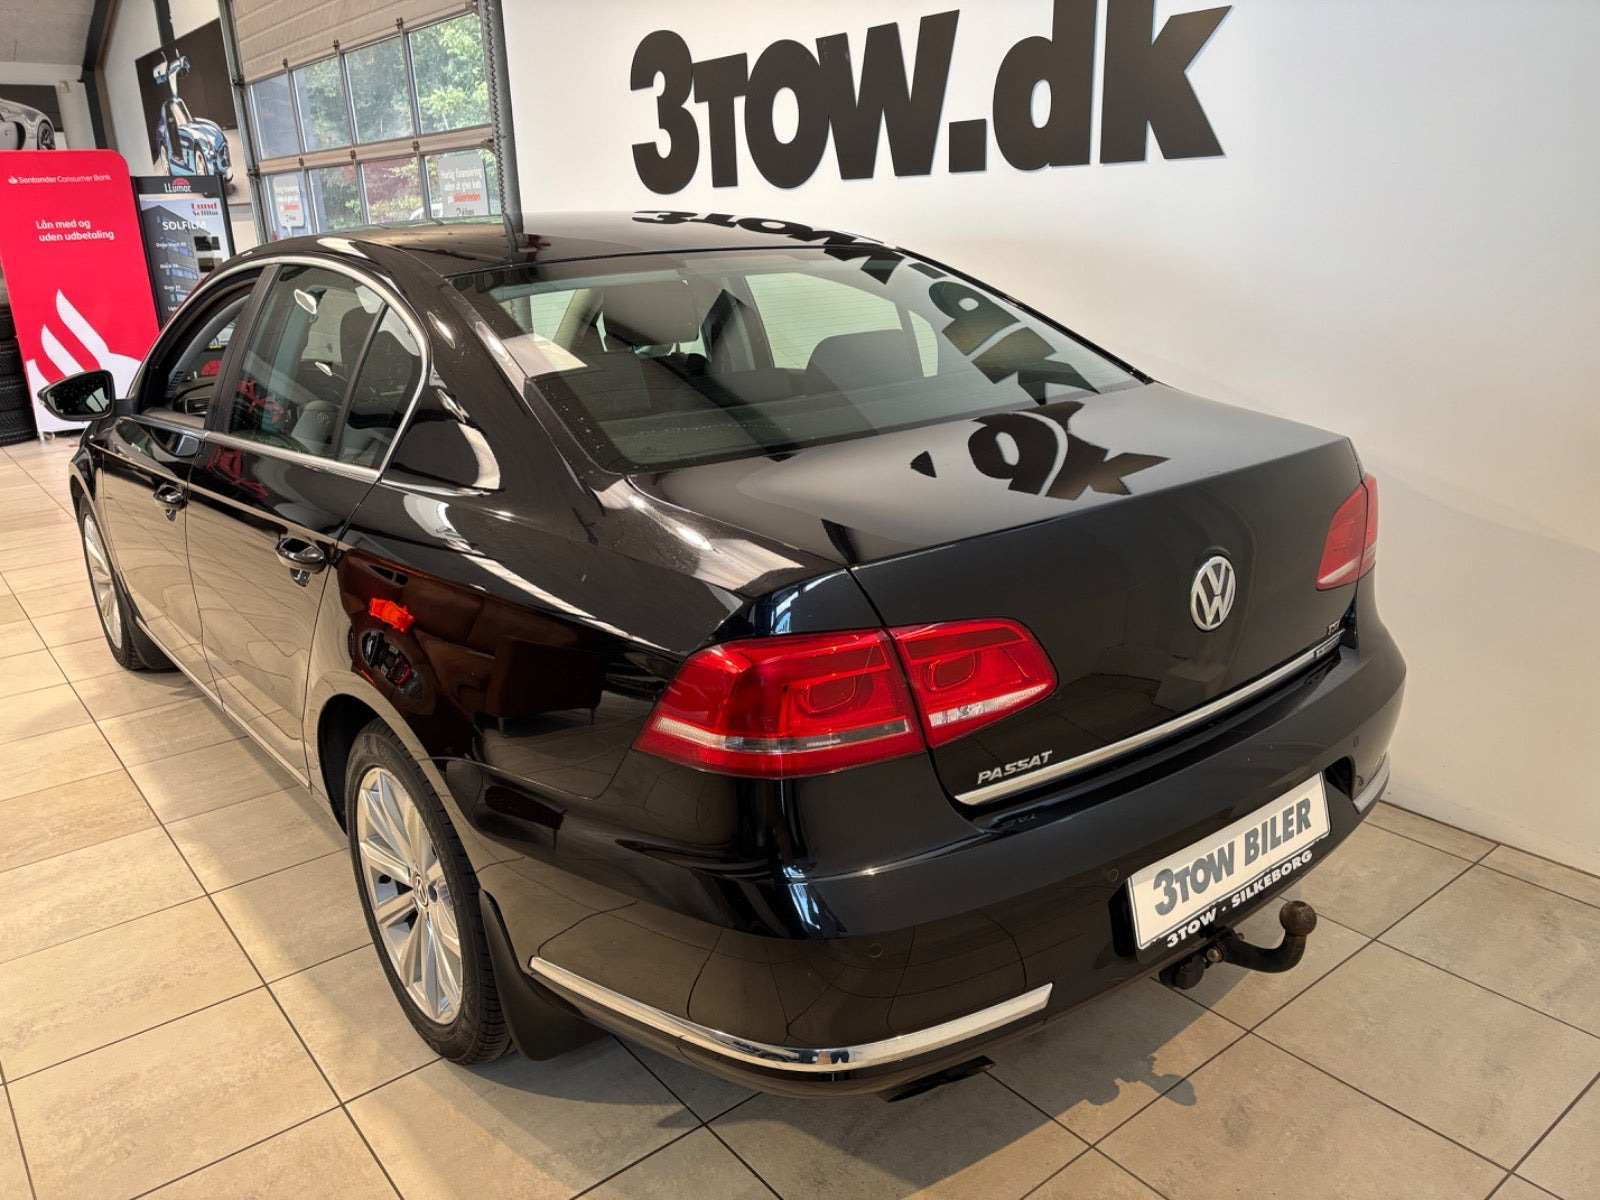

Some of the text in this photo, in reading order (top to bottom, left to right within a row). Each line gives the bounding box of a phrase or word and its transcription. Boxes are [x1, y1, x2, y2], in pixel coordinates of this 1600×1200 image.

[630, 0, 1233, 194] 3TOW.dk
[18, 176, 57, 184] Santander
[57, 175, 93, 183] Consumer
[36, 219, 91, 230] Lån med og
[39, 230, 115, 242] uden udbetaling
[162, 220, 207, 231] SOLFILM
[977, 749, 1053, 784] PASSAT
[1153, 798, 1312, 916] 3TOW BILER
[1167, 908, 1217, 948] 3TOW
[1231, 849, 1313, 908] SILKEBORG
